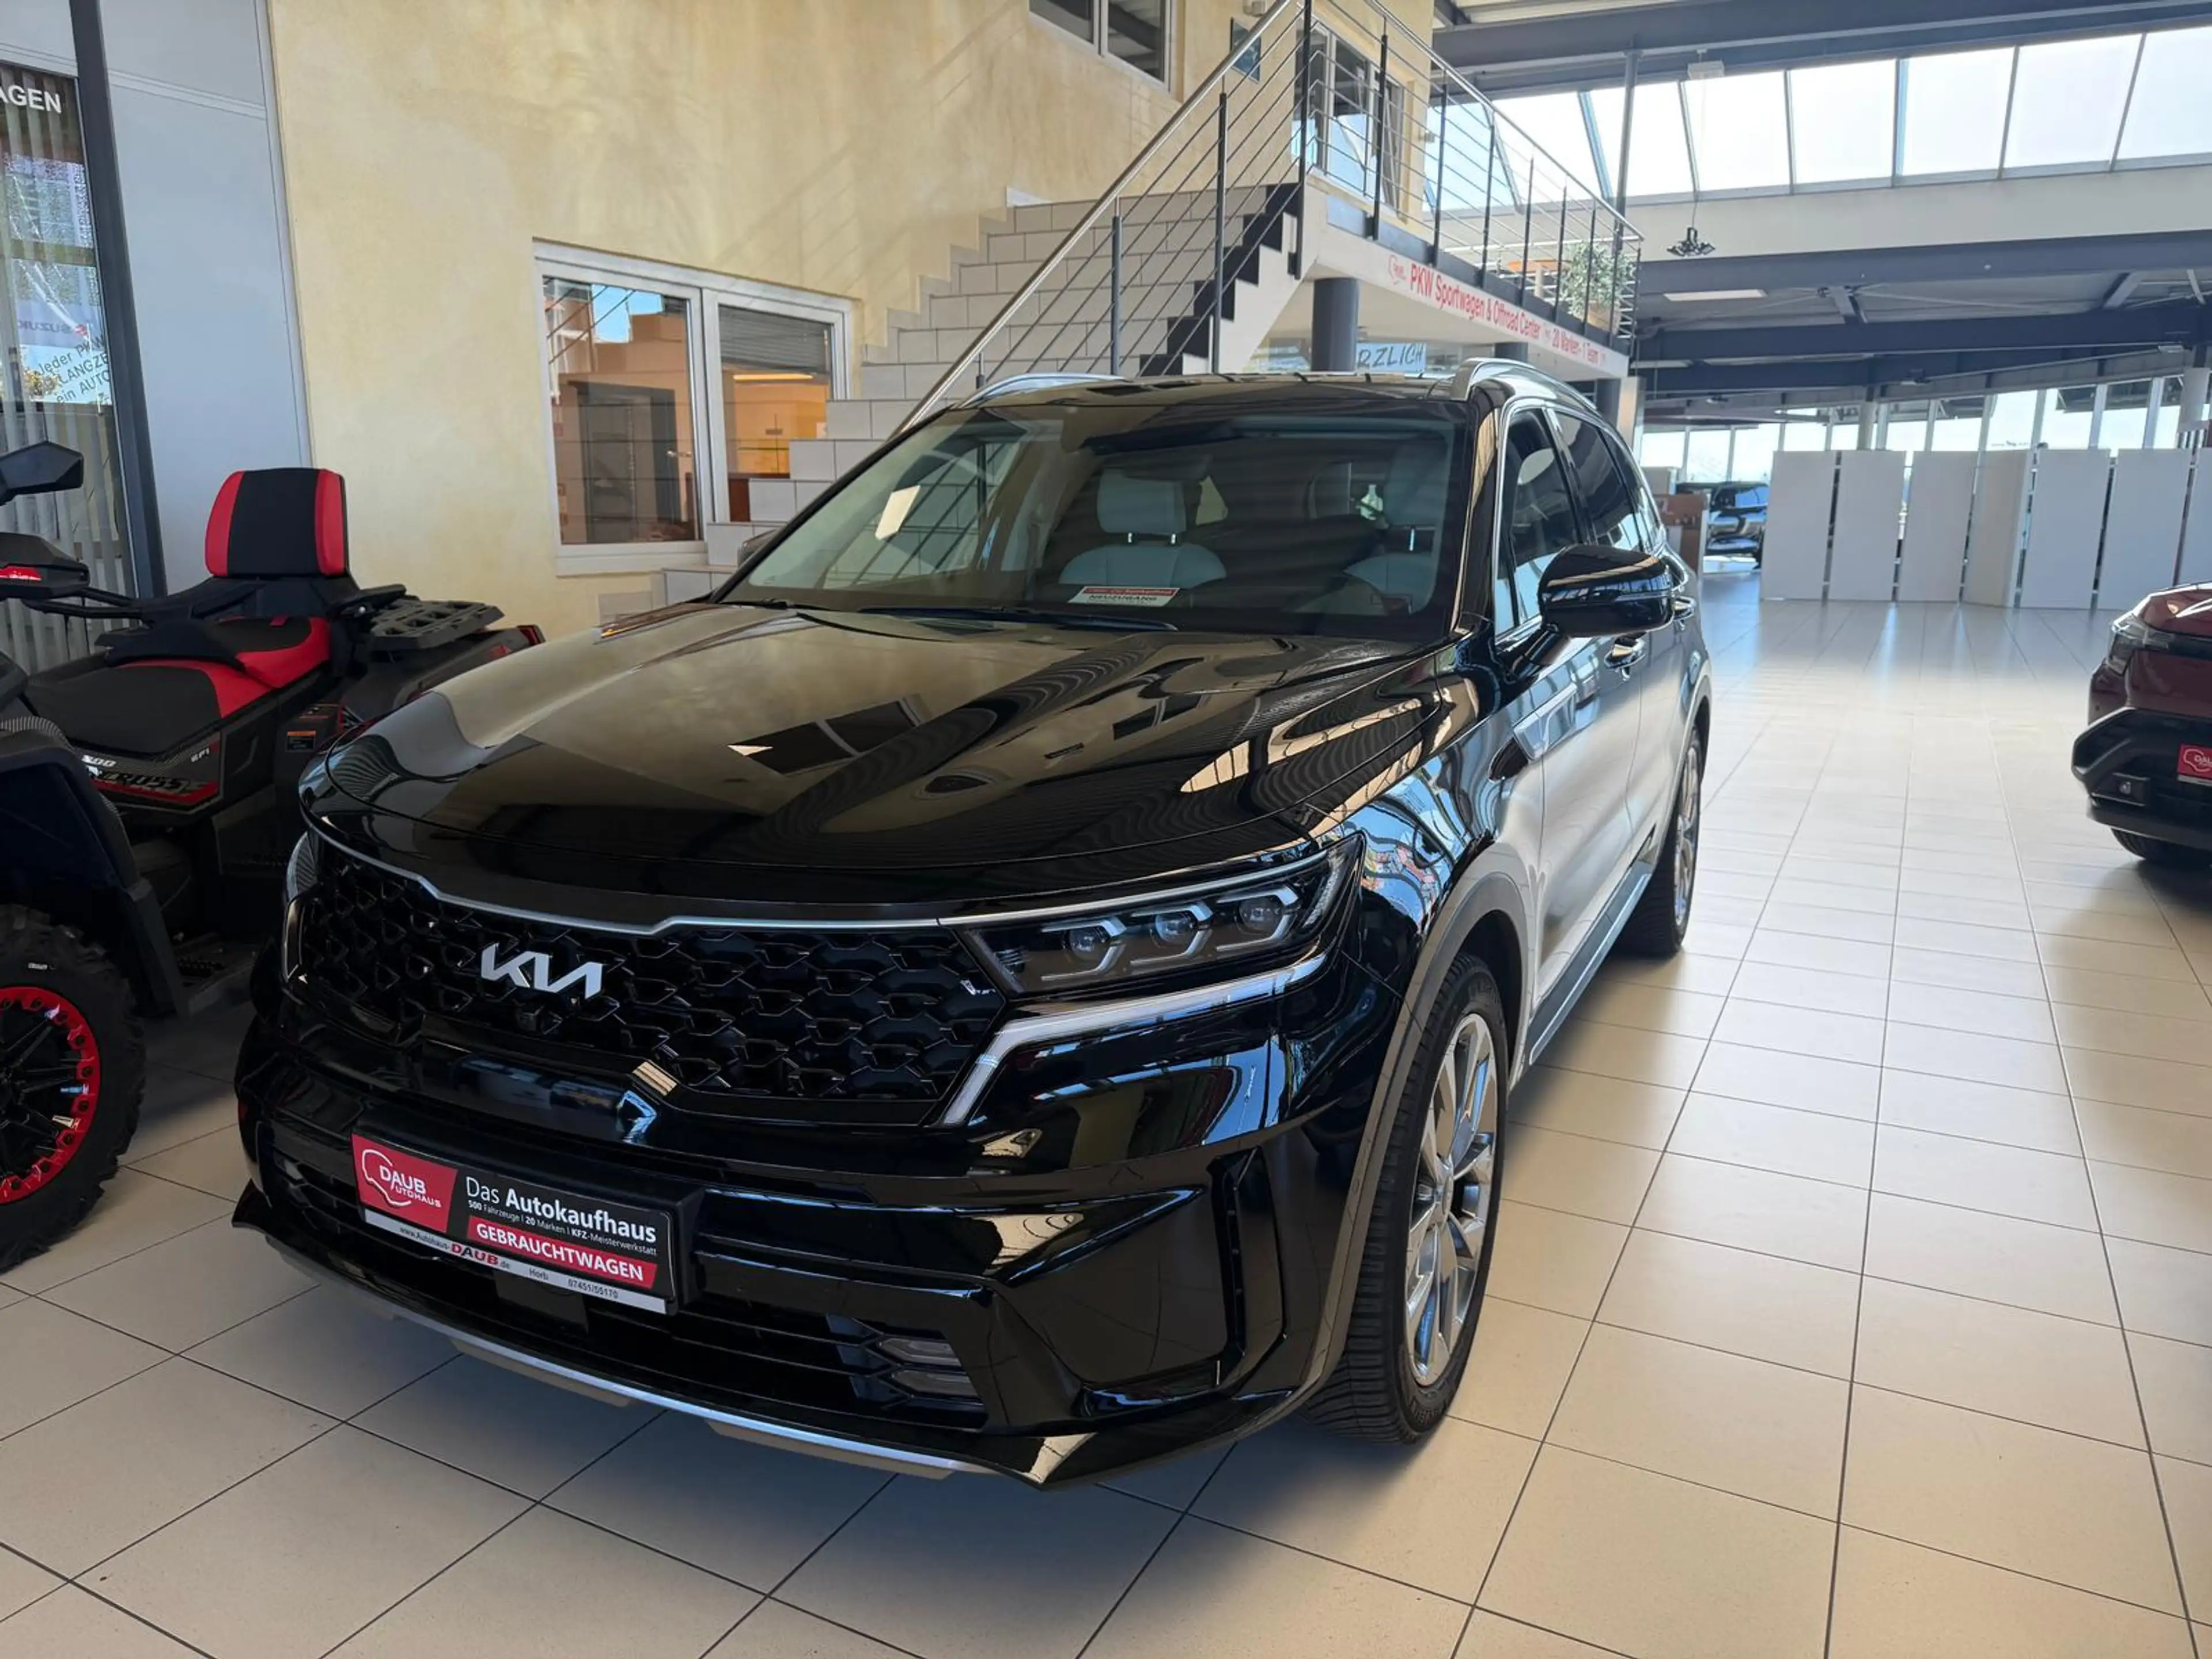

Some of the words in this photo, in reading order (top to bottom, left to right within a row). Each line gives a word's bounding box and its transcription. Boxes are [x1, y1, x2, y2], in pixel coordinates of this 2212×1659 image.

[1410, 263, 1434, 297] PKW
[1435, 275, 1484, 321] Sportwagen
[1486, 298, 1492, 321] &
[1493, 300, 1519, 332] Offroad
[1519, 311, 1541, 339] Center
[38, 353, 73, 376] Jeder
[481, 942, 603, 1000] KIA
[378, 1165, 426, 1195] DAUB
[465, 1176, 500, 1204] Das
[505, 1188, 657, 1243] Autokaufhaus
[468, 1199, 482, 1210] 500
[483, 1204, 520, 1222] Fahrzeuge
[525, 1216, 536, 1226] 20
[536, 1219, 566, 1234] Marken
[571, 1229, 657, 1256] KFZ-Meisterwerkstatt
[476, 1222, 643, 1282] GEBRAUCHTWAGEN
[567, 1278, 619, 1299] 07451/55170
